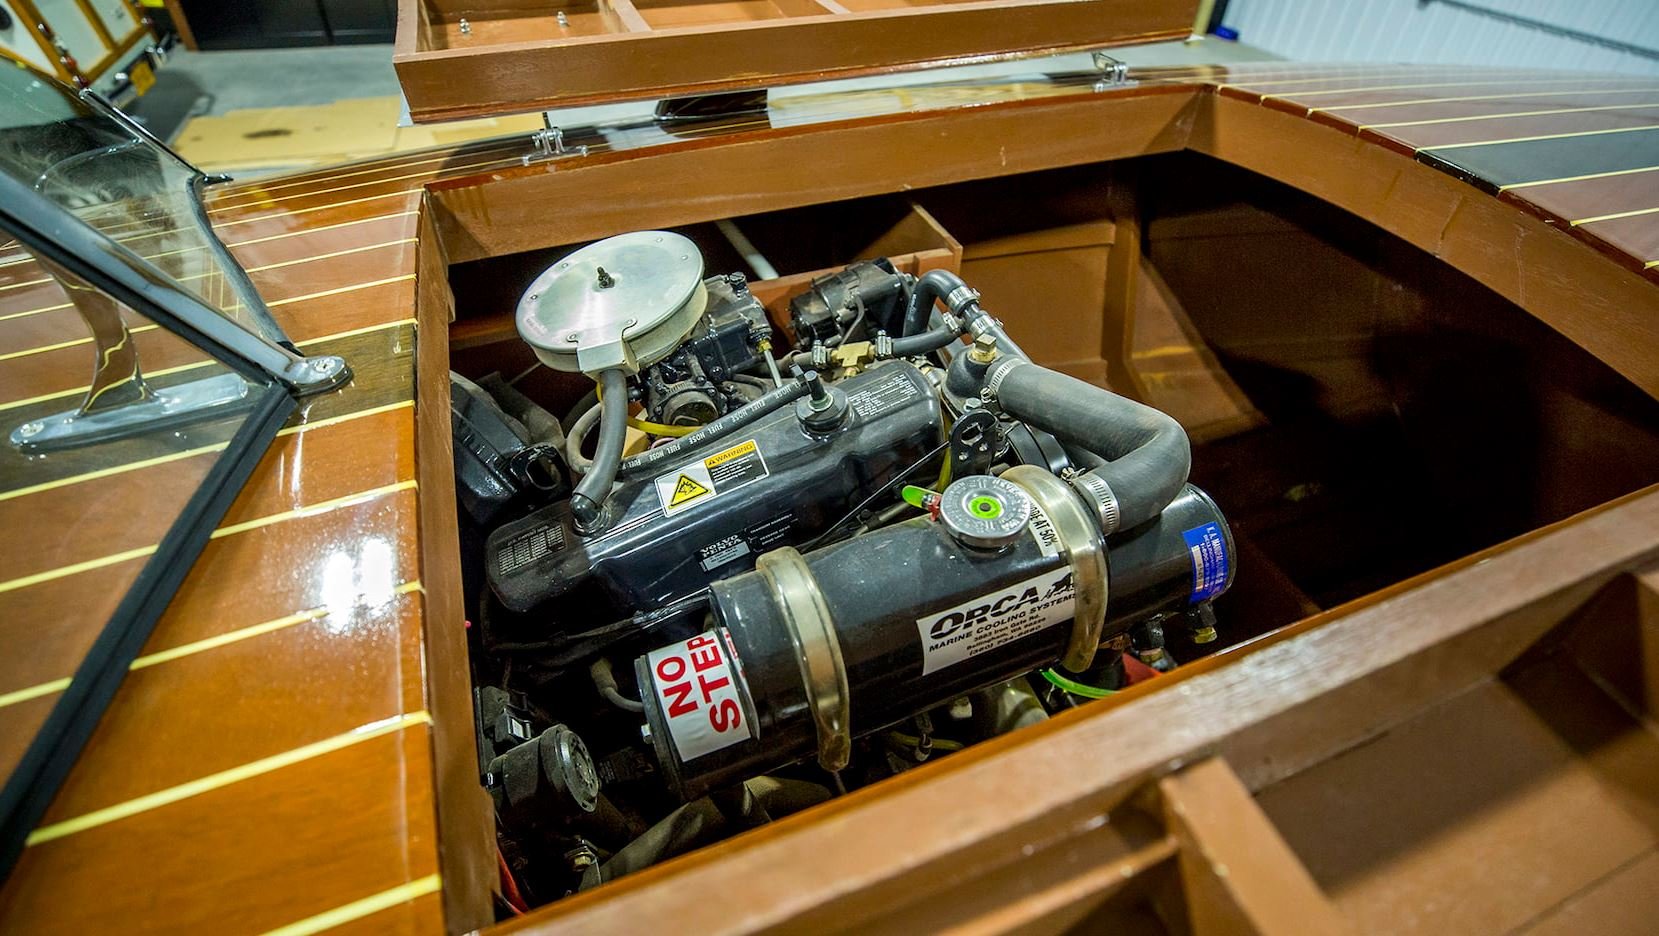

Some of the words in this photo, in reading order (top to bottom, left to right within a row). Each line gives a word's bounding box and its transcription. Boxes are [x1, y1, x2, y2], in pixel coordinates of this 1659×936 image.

[751, 399, 766, 413] FUEL
[731, 410, 748, 423] HOSE
[707, 422, 724, 435] FUEL
[688, 431, 706, 444] HOSE
[648, 449, 665, 462] HOSE
[666, 443, 681, 455] FUEL
[715, 444, 753, 462] WARNING
[628, 458, 642, 468] FUEL
[1032, 519, 1051, 530] AT
[700, 534, 739, 553] VOLVO
[1039, 529, 1059, 547] 50%
[703, 538, 742, 558] PENTA
[930, 586, 1040, 640] ORCA
[929, 631, 973, 653] MARINE
[976, 611, 1027, 635] COOLING
[656, 656, 699, 719] NO
[687, 636, 741, 733] STEP
